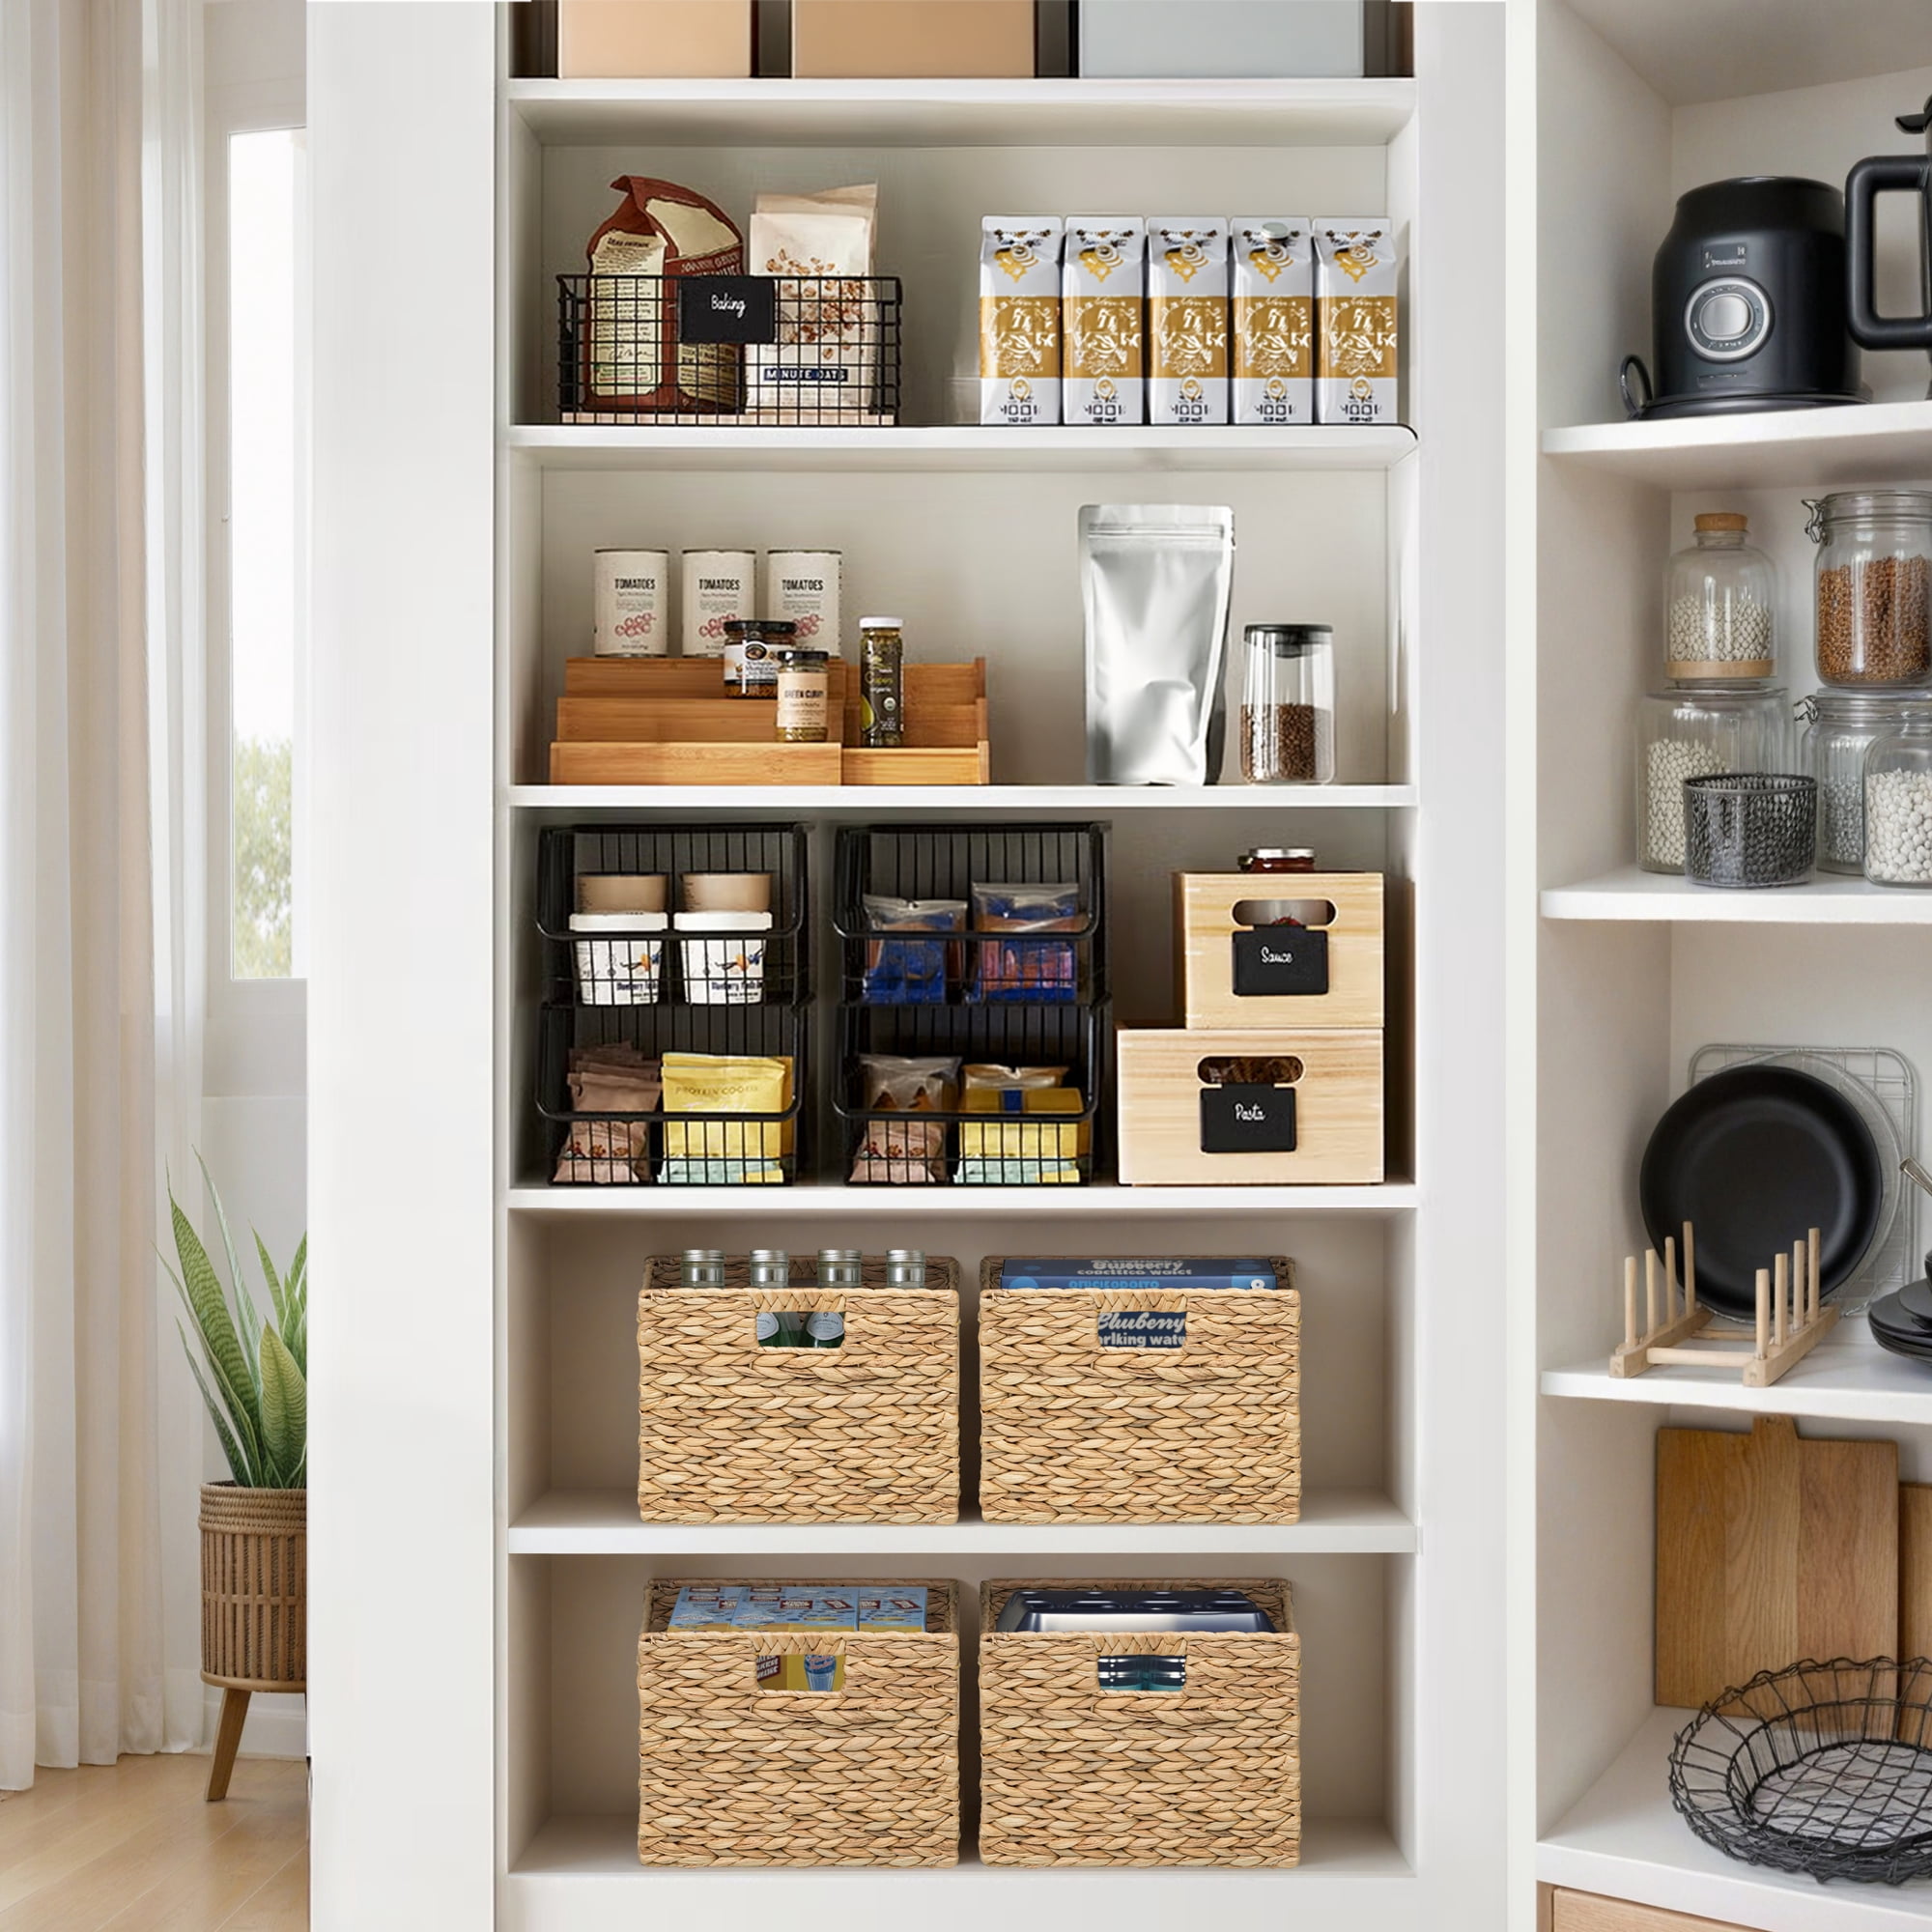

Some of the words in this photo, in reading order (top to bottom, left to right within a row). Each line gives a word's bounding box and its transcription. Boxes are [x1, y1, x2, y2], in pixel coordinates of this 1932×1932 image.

[711, 293, 746, 318] Baking
[614, 579, 655, 589] TOMATOES
[698, 579, 740, 590] TOMATOES
[781, 580, 824, 591] TOMATOES
[1261, 946, 1293, 963] Sauce
[1236, 1103, 1265, 1121] Pasta
